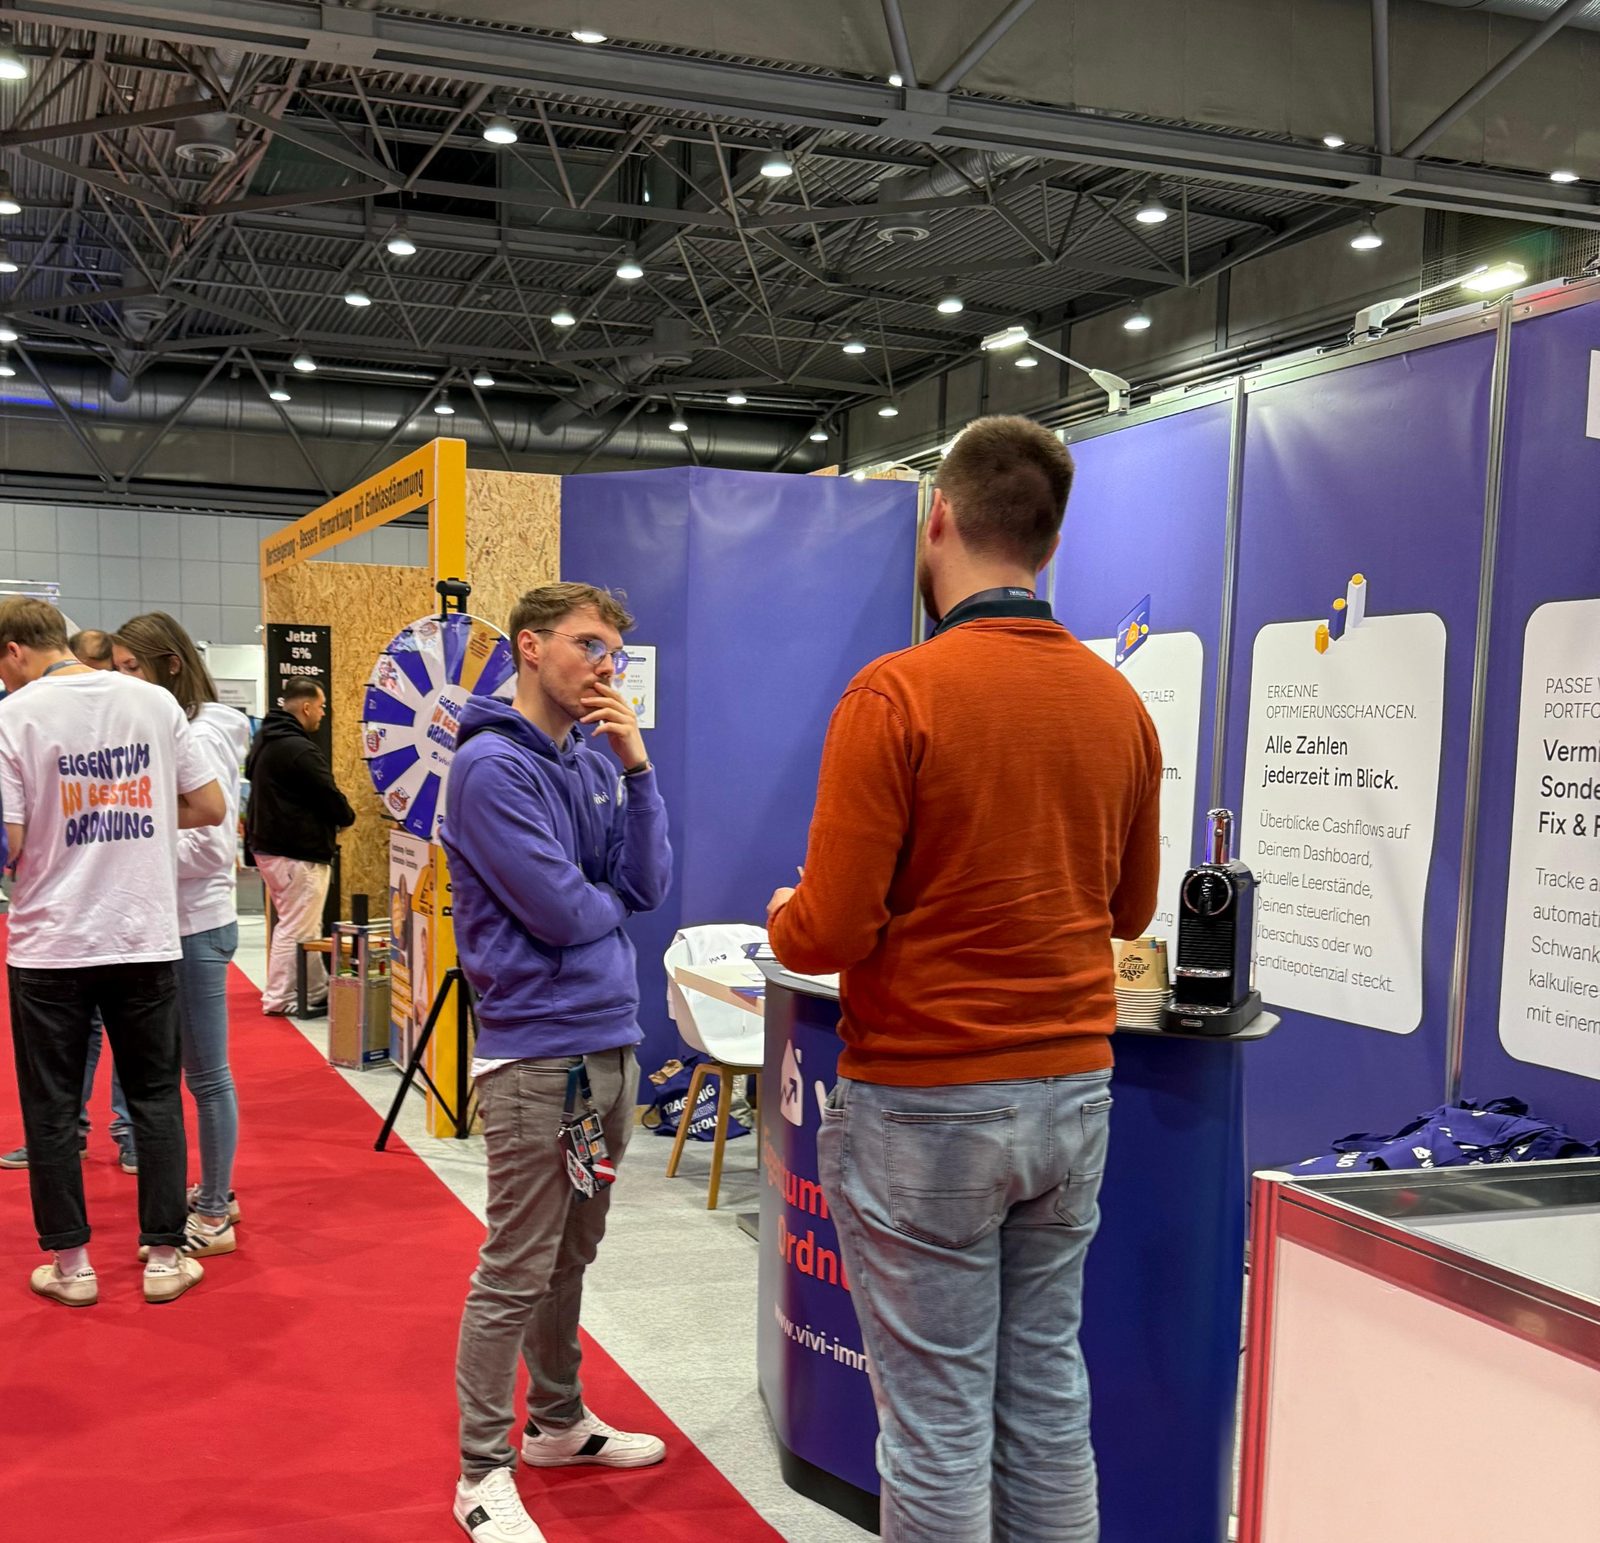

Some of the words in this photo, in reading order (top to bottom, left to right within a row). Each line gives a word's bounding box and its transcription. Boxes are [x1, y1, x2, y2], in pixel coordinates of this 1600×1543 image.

[319, 507, 353, 541] Vermarktung
[353, 495, 365, 523] mit
[285, 630, 318, 643] Jetzt
[291, 647, 312, 660] 5%
[279, 662, 325, 676] Messe-
[1267, 684, 1319, 699] ERKENNE
[1545, 677, 1593, 694] PASSE
[1266, 704, 1417, 720] OPTIMIERUNGSCHANCEN.
[1265, 735, 1292, 754] Alle
[1296, 736, 1348, 756] Zahlen
[58, 743, 150, 780] EIGENTUM
[1262, 764, 1330, 787] jederzeit
[1334, 767, 1353, 787] im
[1356, 768, 1399, 790] Blick.
[1540, 775, 1600, 800] Sonde
[61, 780, 83, 818] IN
[88, 775, 153, 809] BESTER
[65, 809, 155, 848] ORDNUNG
[1259, 808, 1320, 832] Überblicke
[1322, 817, 1385, 838] Cashflows
[1387, 823, 1412, 839] auf
[1538, 811, 1566, 835] Fix
[1573, 813, 1587, 837] &
[1258, 840, 1301, 859] Deinem
[1303, 844, 1373, 868] Dashboard,
[1256, 869, 1300, 888] aktuelle
[1301, 873, 1373, 899] Leerstände,
[1535, 867, 1585, 891] Tracke
[1296, 903, 1371, 927] steuerlichen
[1321, 937, 1351, 954] oder
[1353, 945, 1373, 958] wo
[1531, 935, 1600, 964] Schwank
[1351, 971, 1396, 993] steckt.
[1528, 969, 1600, 999] kalkuliere
[1526, 1004, 1552, 1024] mit
[1555, 1010, 1600, 1035] einem
